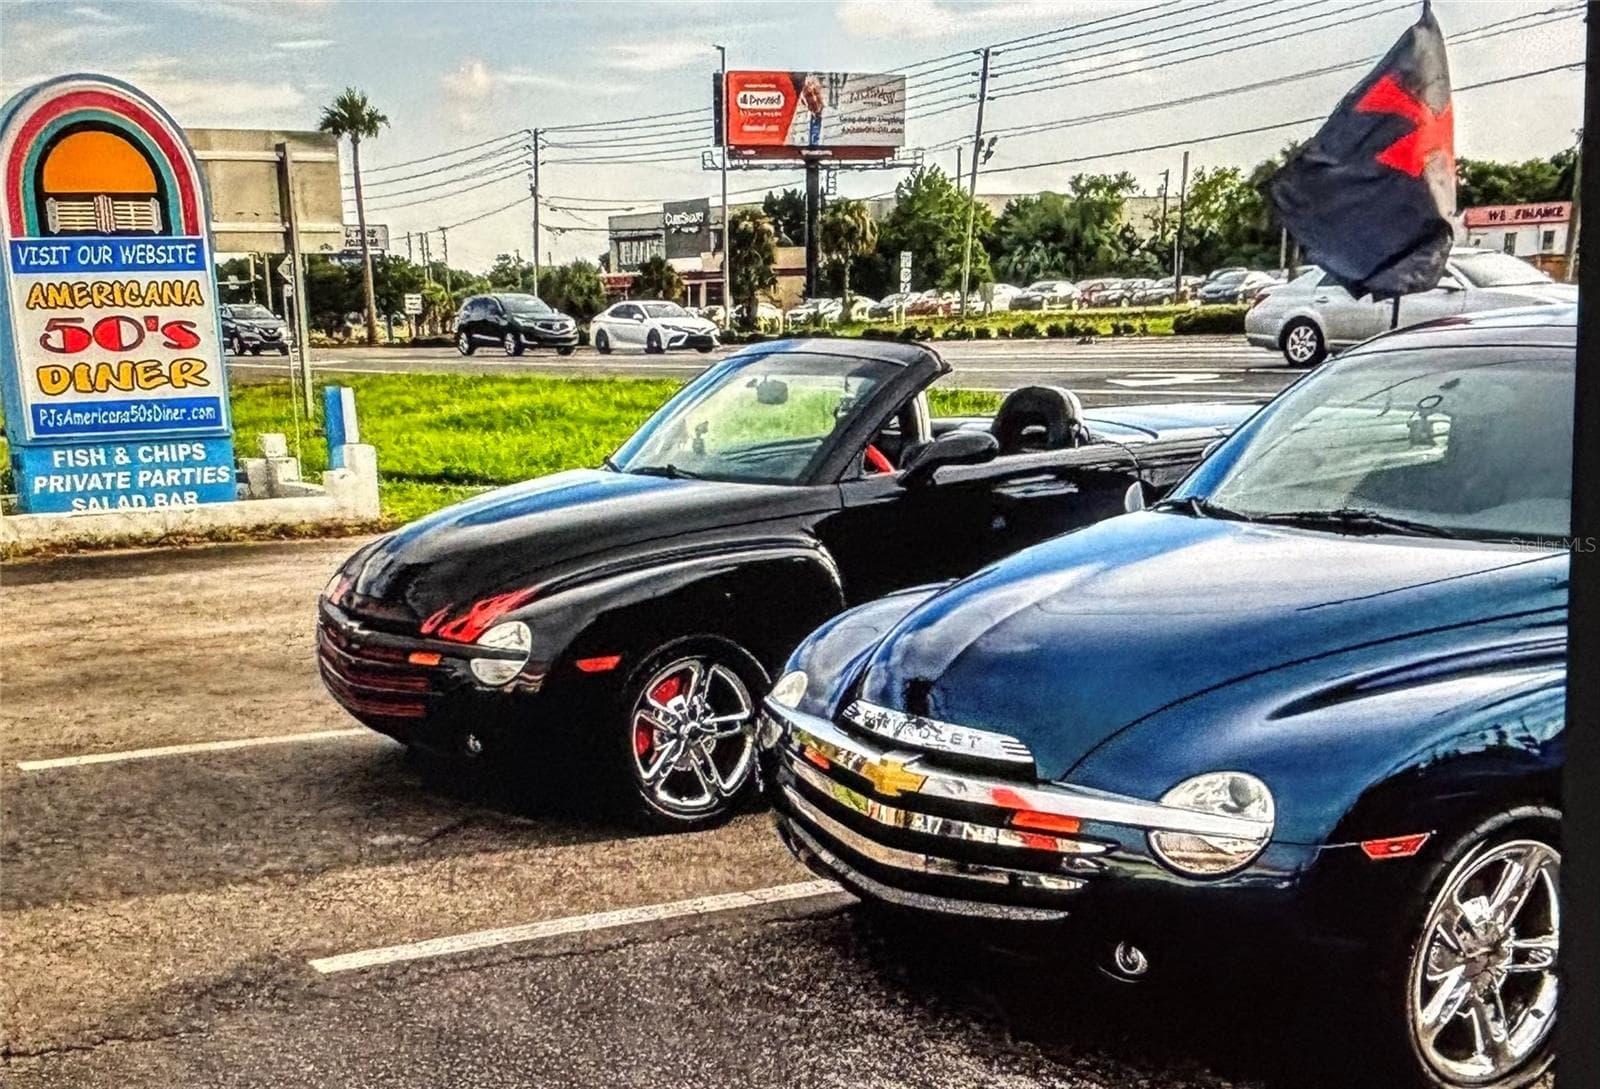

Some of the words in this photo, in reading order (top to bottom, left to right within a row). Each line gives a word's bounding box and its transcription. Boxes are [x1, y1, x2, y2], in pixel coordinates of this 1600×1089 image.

[1514, 206, 1564, 220] FINANCE
[18, 246, 71, 266] VISIT
[77, 245, 113, 265] OUR
[120, 243, 197, 265] WEBSITE
[26, 279, 205, 310] AMERICANA
[36, 358, 210, 396] DINER
[39, 404, 216, 428] PJsAmericana50sDiner.com
[52, 447, 106, 468] FISH
[114, 446, 132, 465] &
[137, 443, 207, 463] CHIPS
[33, 471, 131, 494] PRIVATE
[136, 466, 231, 489] PARTIES
[153, 491, 199, 507] BAR
